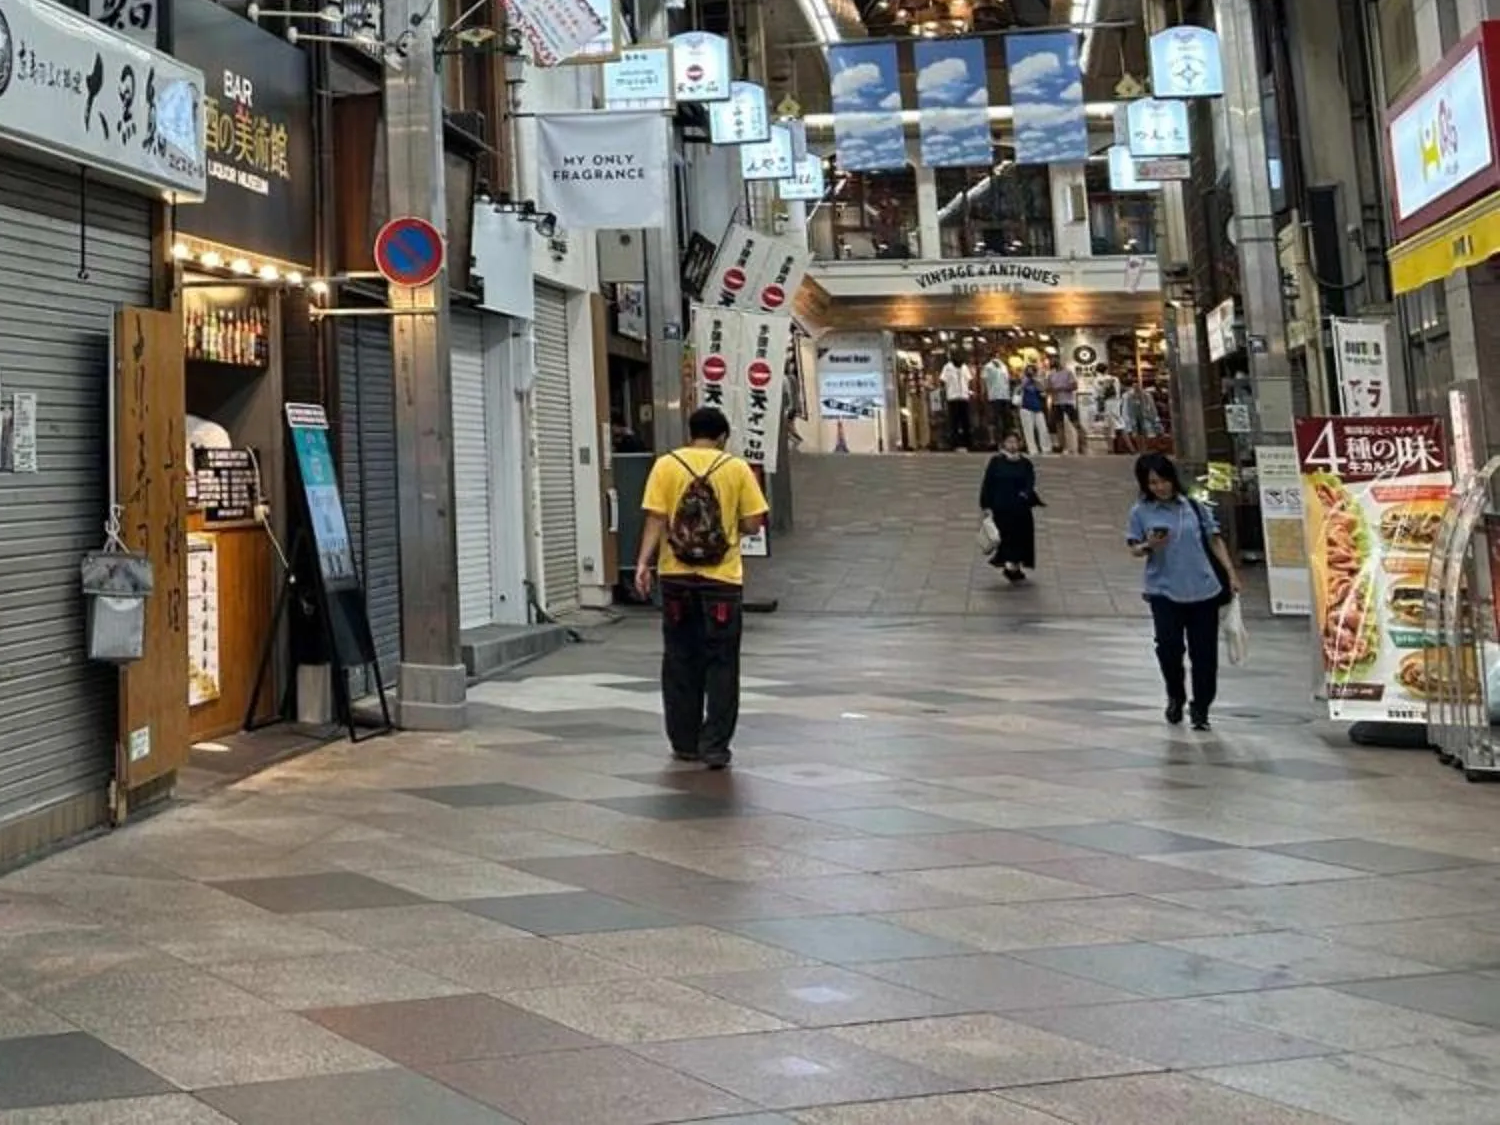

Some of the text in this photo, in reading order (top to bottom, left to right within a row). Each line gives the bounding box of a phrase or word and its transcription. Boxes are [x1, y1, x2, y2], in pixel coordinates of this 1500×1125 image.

[223, 69, 253, 108] BAR
[563, 155, 634, 166] MY ONLY
[552, 168, 645, 181] FRAGRANCE
[916, 265, 974, 288] VINTAGE
[989, 264, 1060, 286] ANTIQUES
